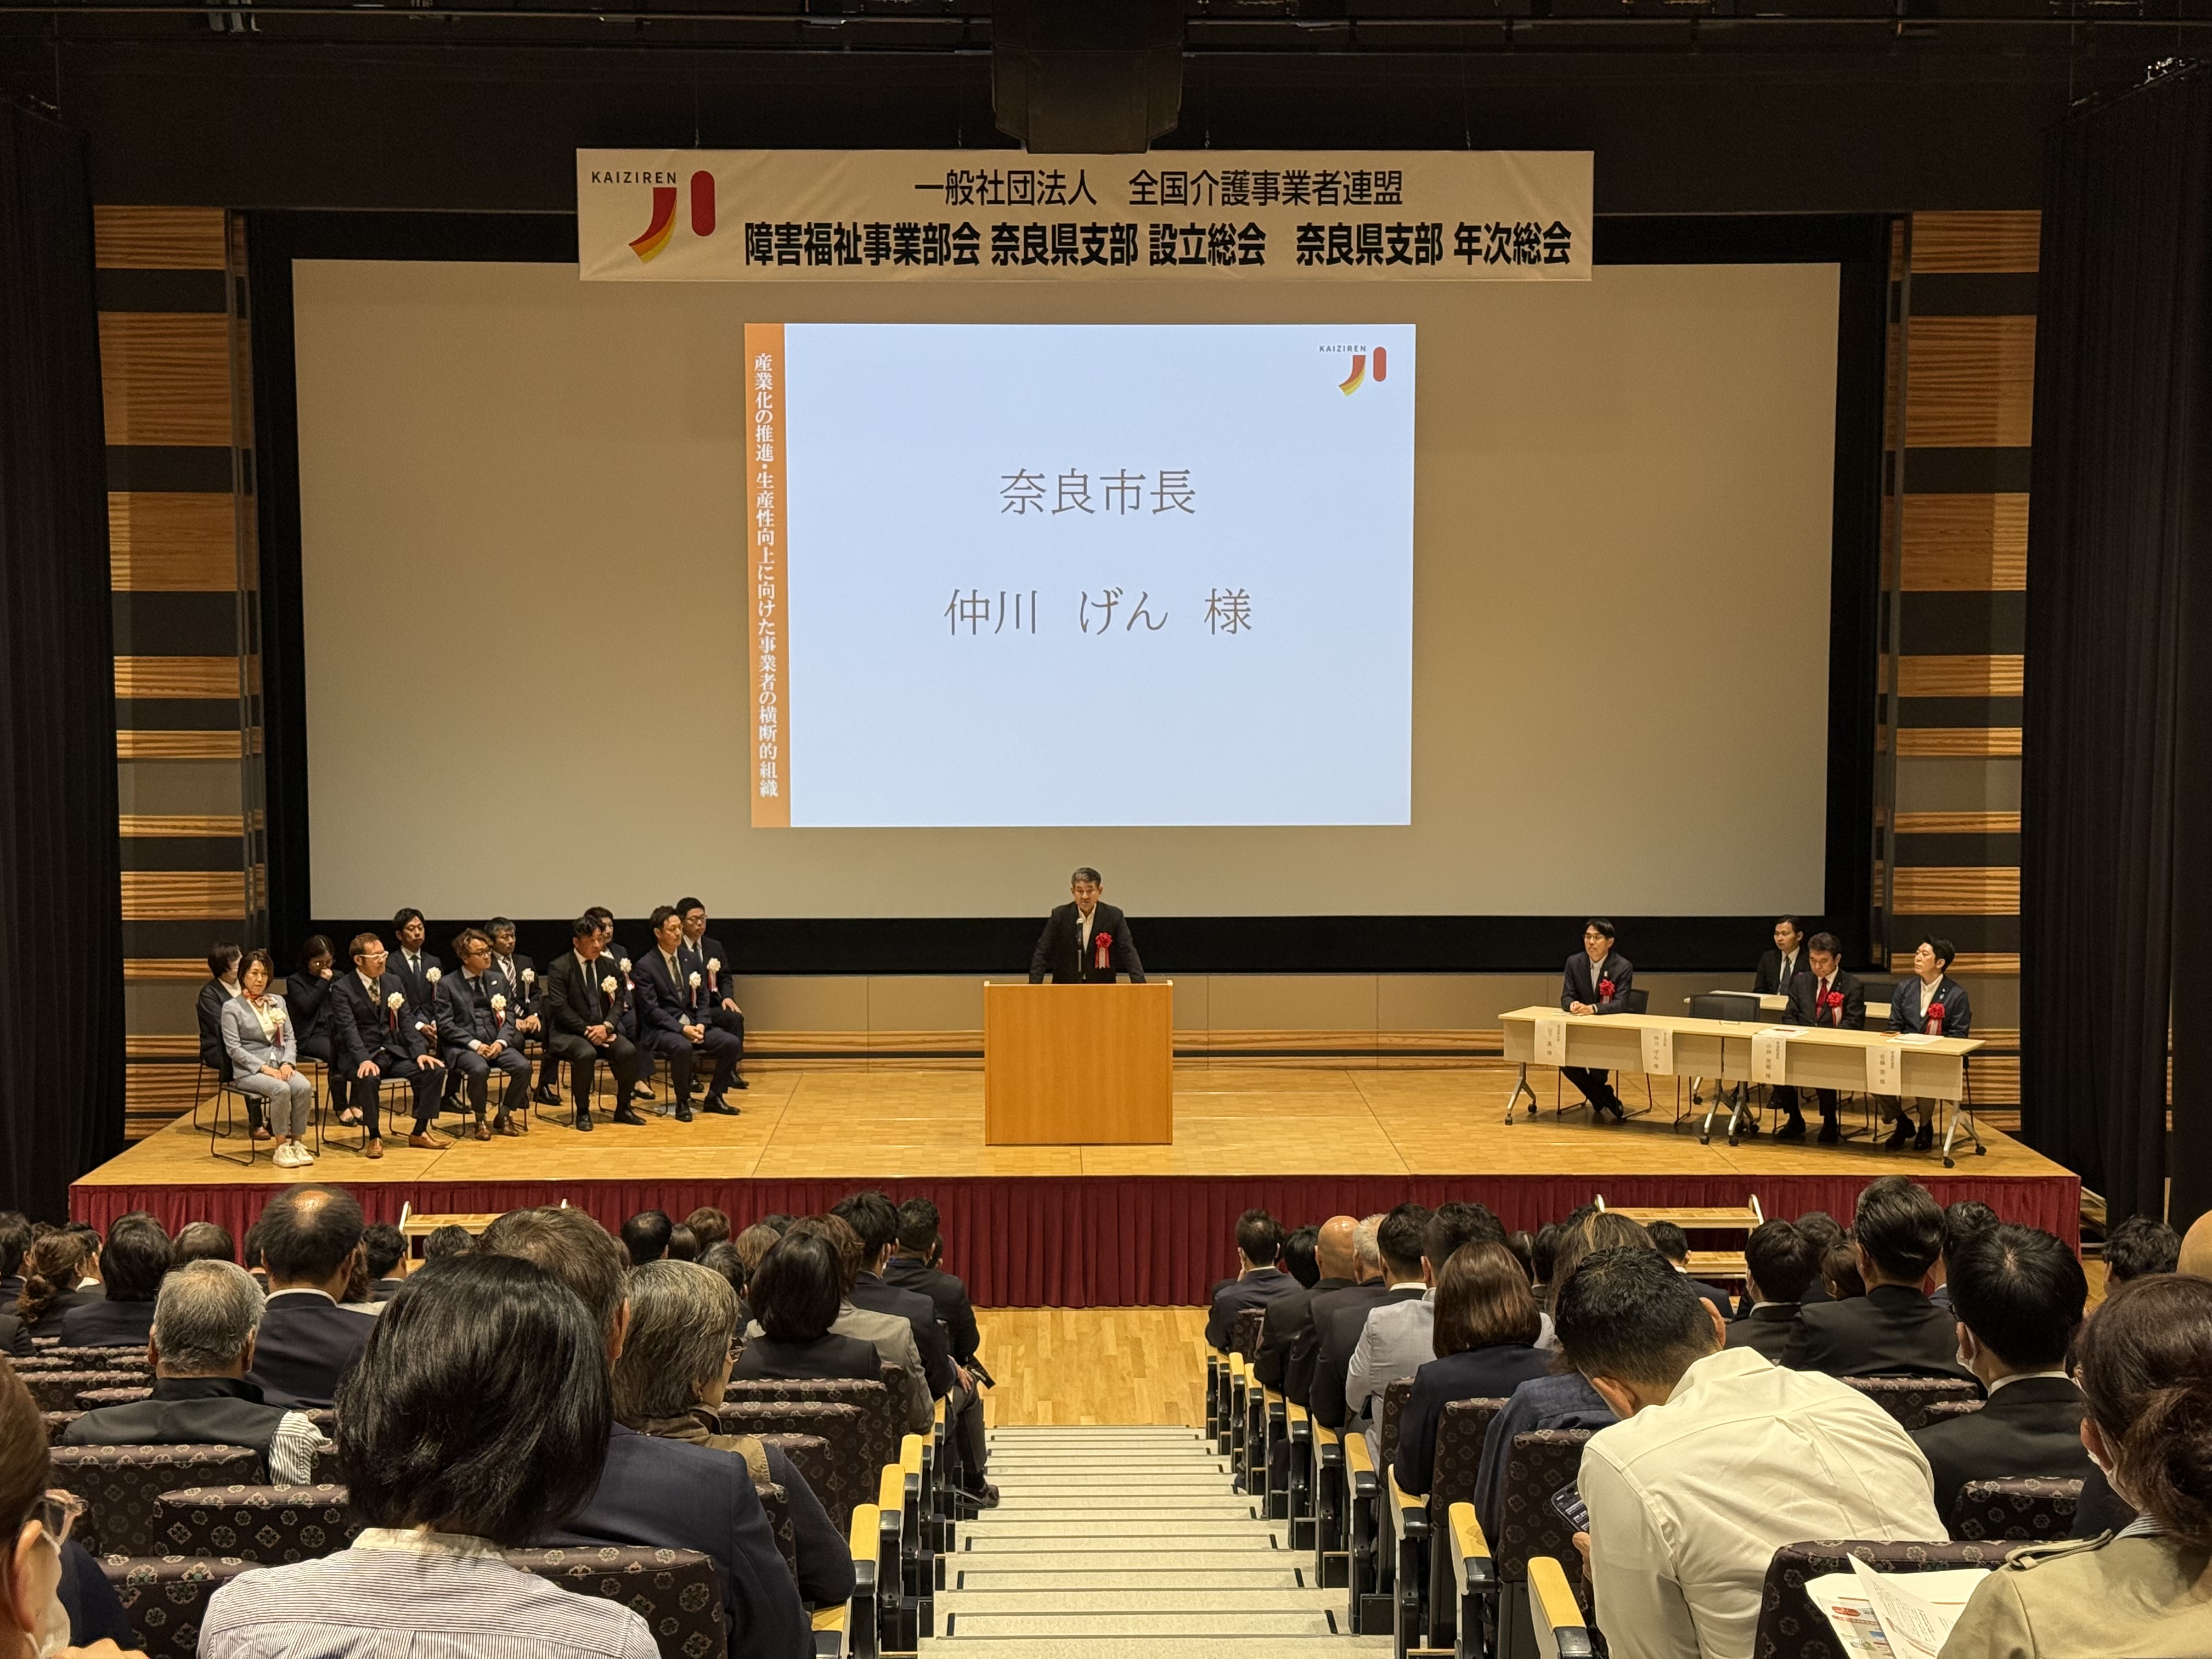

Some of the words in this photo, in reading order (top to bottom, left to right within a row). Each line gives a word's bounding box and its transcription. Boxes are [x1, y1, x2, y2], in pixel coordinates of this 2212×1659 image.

[591, 171, 676, 184] KAIZIREN
[915, 168, 1097, 206] 一般社団法人
[1128, 169, 1403, 206] 全国介護事業者連盟
[745, 221, 981, 266] 障害福祉事業部会
[991, 222, 1138, 267] 奈良県支部
[1149, 222, 1266, 267] 設立総会
[1296, 222, 1443, 266] 奈良県支部
[1453, 221, 1572, 266] 年次総会
[1000, 467, 1195, 515] 奈良市長
[754, 353, 778, 798] 産業化の推進・生産性向上に向けた事業者の横断的組織
[944, 589, 1037, 635] 仲川
[1080, 586, 1168, 635] げん
[1204, 588, 1252, 635] 様
